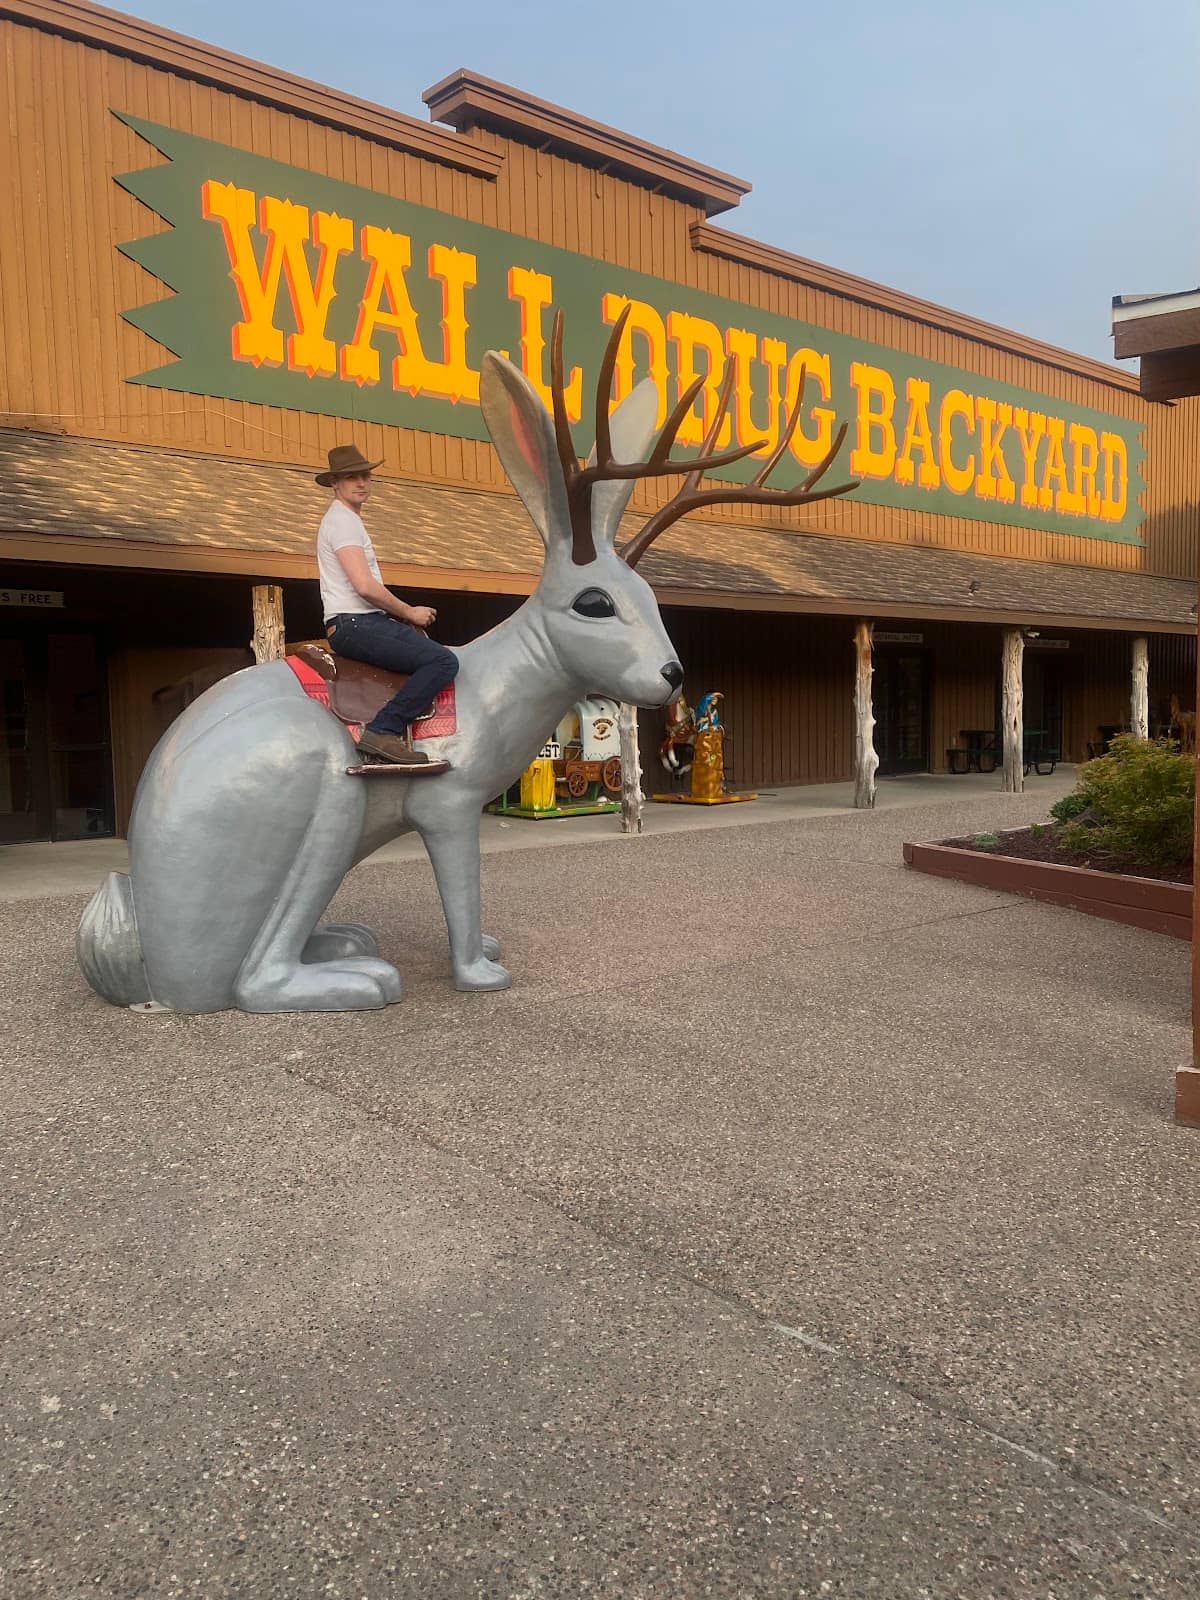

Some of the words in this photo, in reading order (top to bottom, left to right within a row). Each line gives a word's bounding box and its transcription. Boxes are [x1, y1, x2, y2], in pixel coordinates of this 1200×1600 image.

[201, 180, 583, 424] WALL
[601, 293, 836, 469] DRUG
[850, 362, 1129, 523] BACKYARD
[20, 593, 51, 604] FREE
